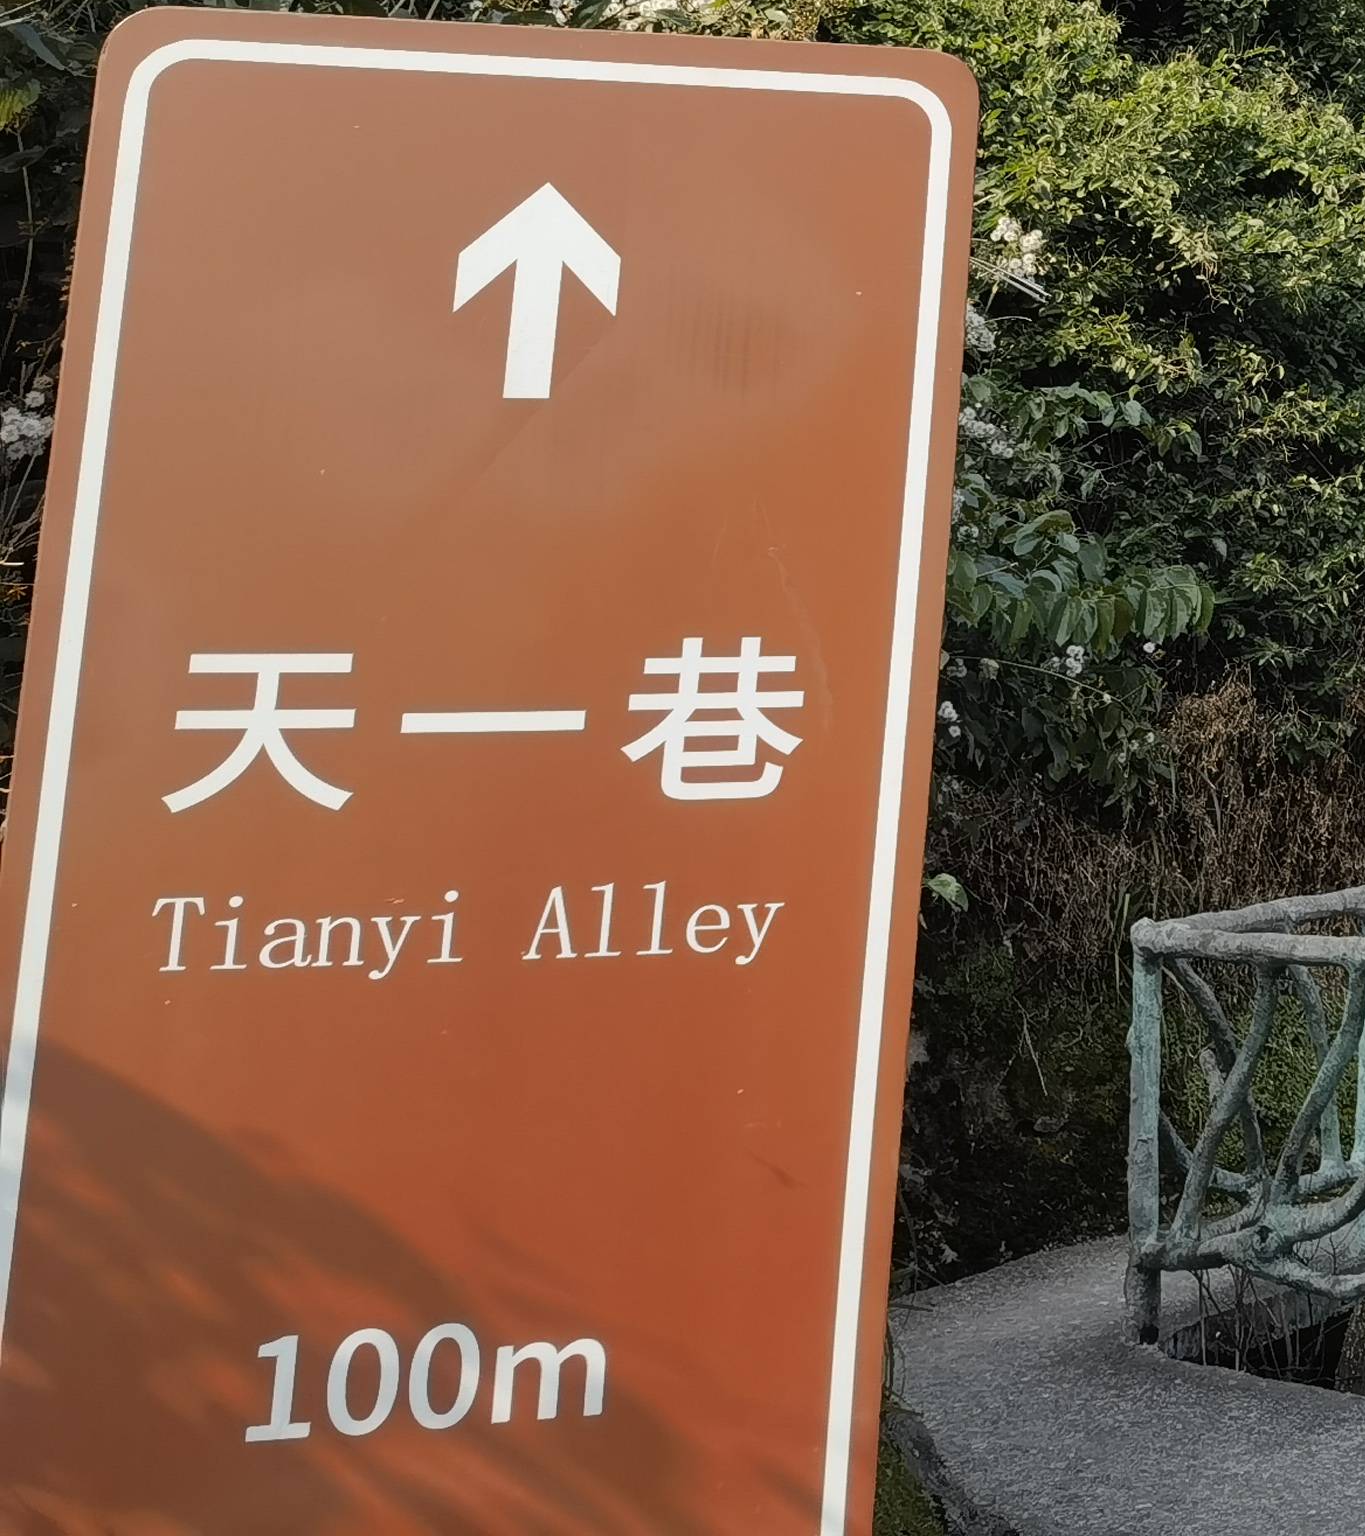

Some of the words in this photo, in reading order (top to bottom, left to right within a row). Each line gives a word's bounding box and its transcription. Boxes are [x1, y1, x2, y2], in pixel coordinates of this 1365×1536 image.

[161, 636, 805, 814] 天一巷
[151, 889, 463, 981] Tianyi
[522, 880, 785, 966] Alley
[245, 1322, 607, 1442] 100m
